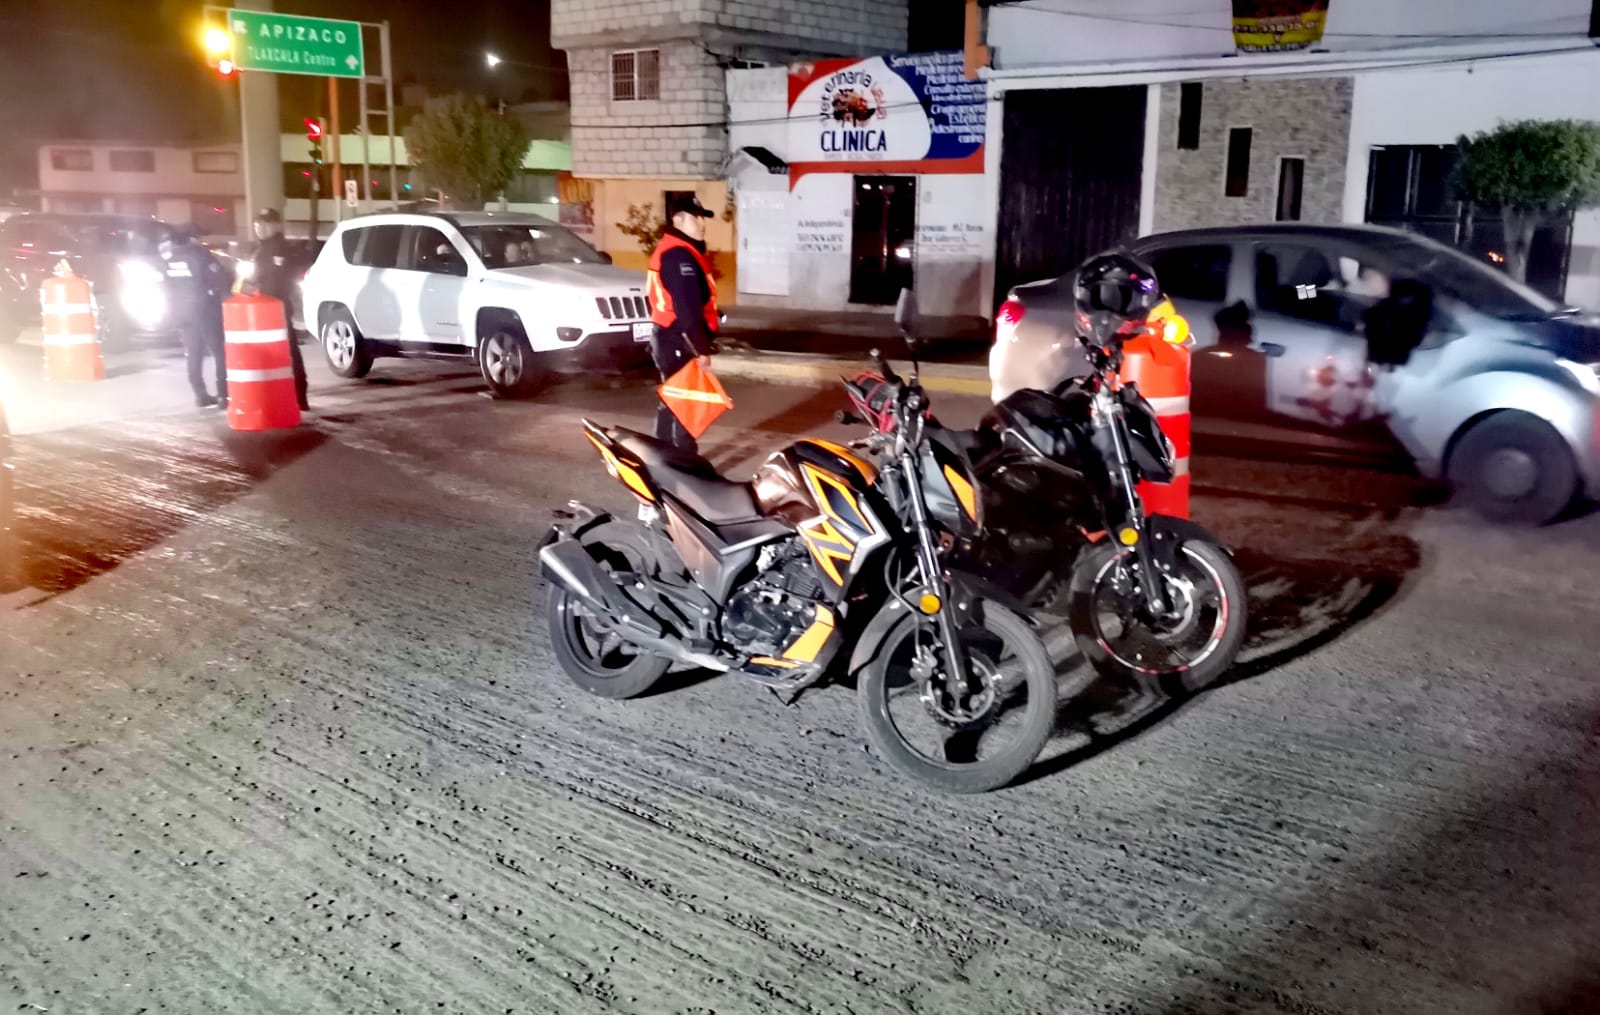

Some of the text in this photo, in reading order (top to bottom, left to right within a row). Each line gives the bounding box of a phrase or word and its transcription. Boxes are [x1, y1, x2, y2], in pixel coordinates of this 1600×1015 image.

[259, 22, 347, 44] APIZACO
[247, 46, 300, 64] TLAXCALA
[820, 130, 887, 152] CLINICA
